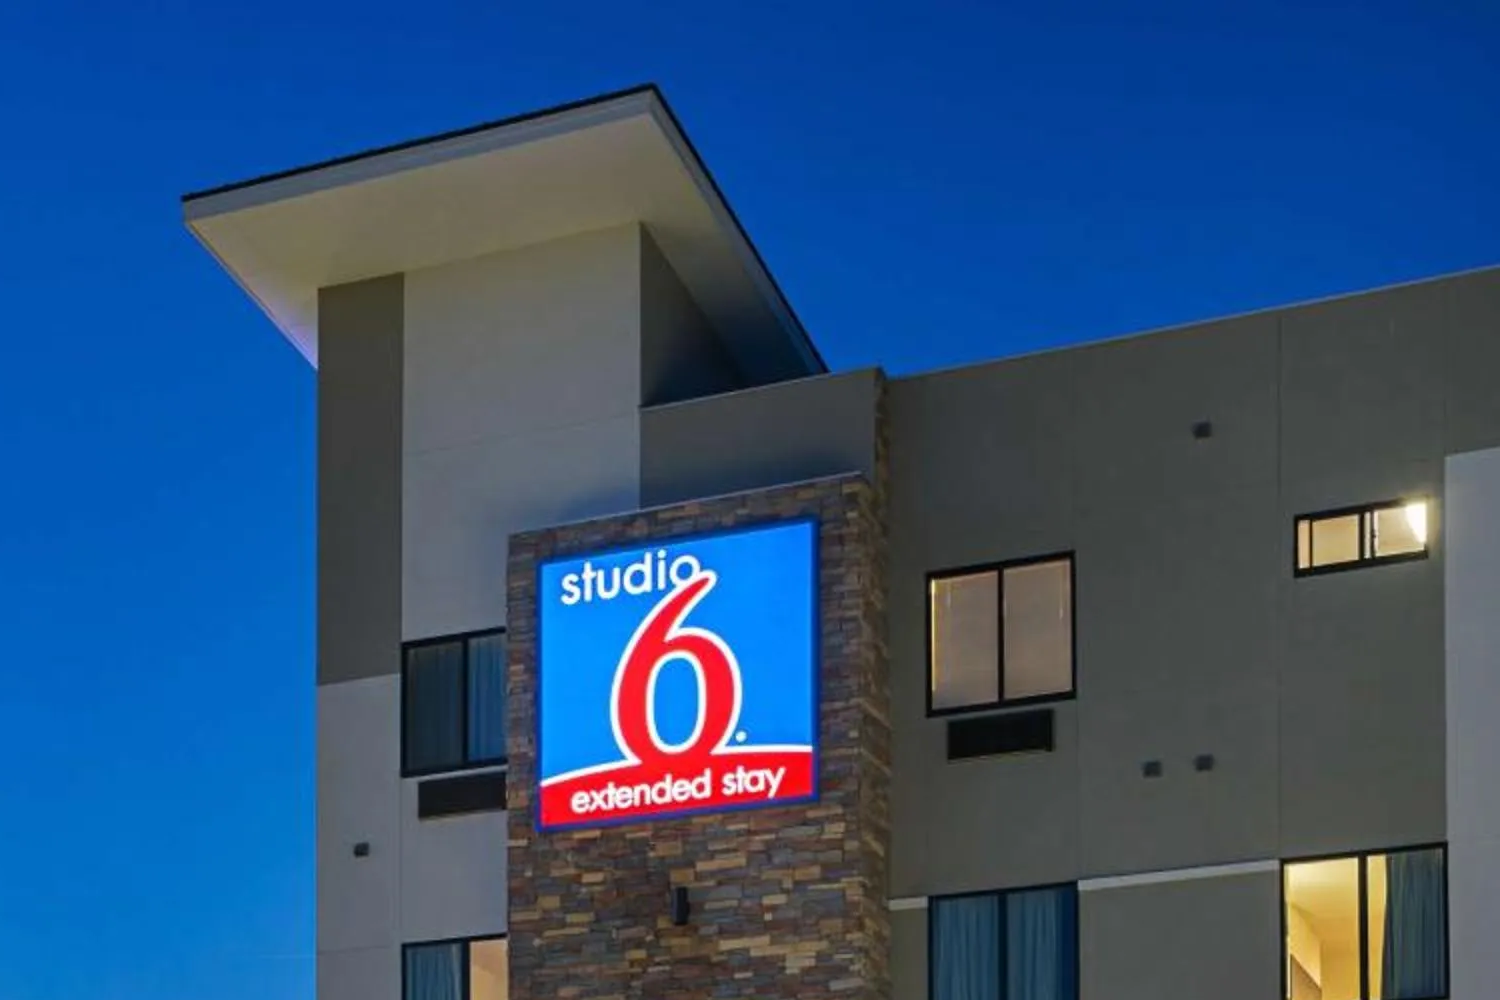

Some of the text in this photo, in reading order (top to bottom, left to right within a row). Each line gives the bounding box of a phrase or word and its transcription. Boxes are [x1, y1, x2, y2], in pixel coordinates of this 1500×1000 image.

[561, 549, 700, 605] studio
[610, 570, 742, 762] 6
[570, 766, 786, 813] extended stay
